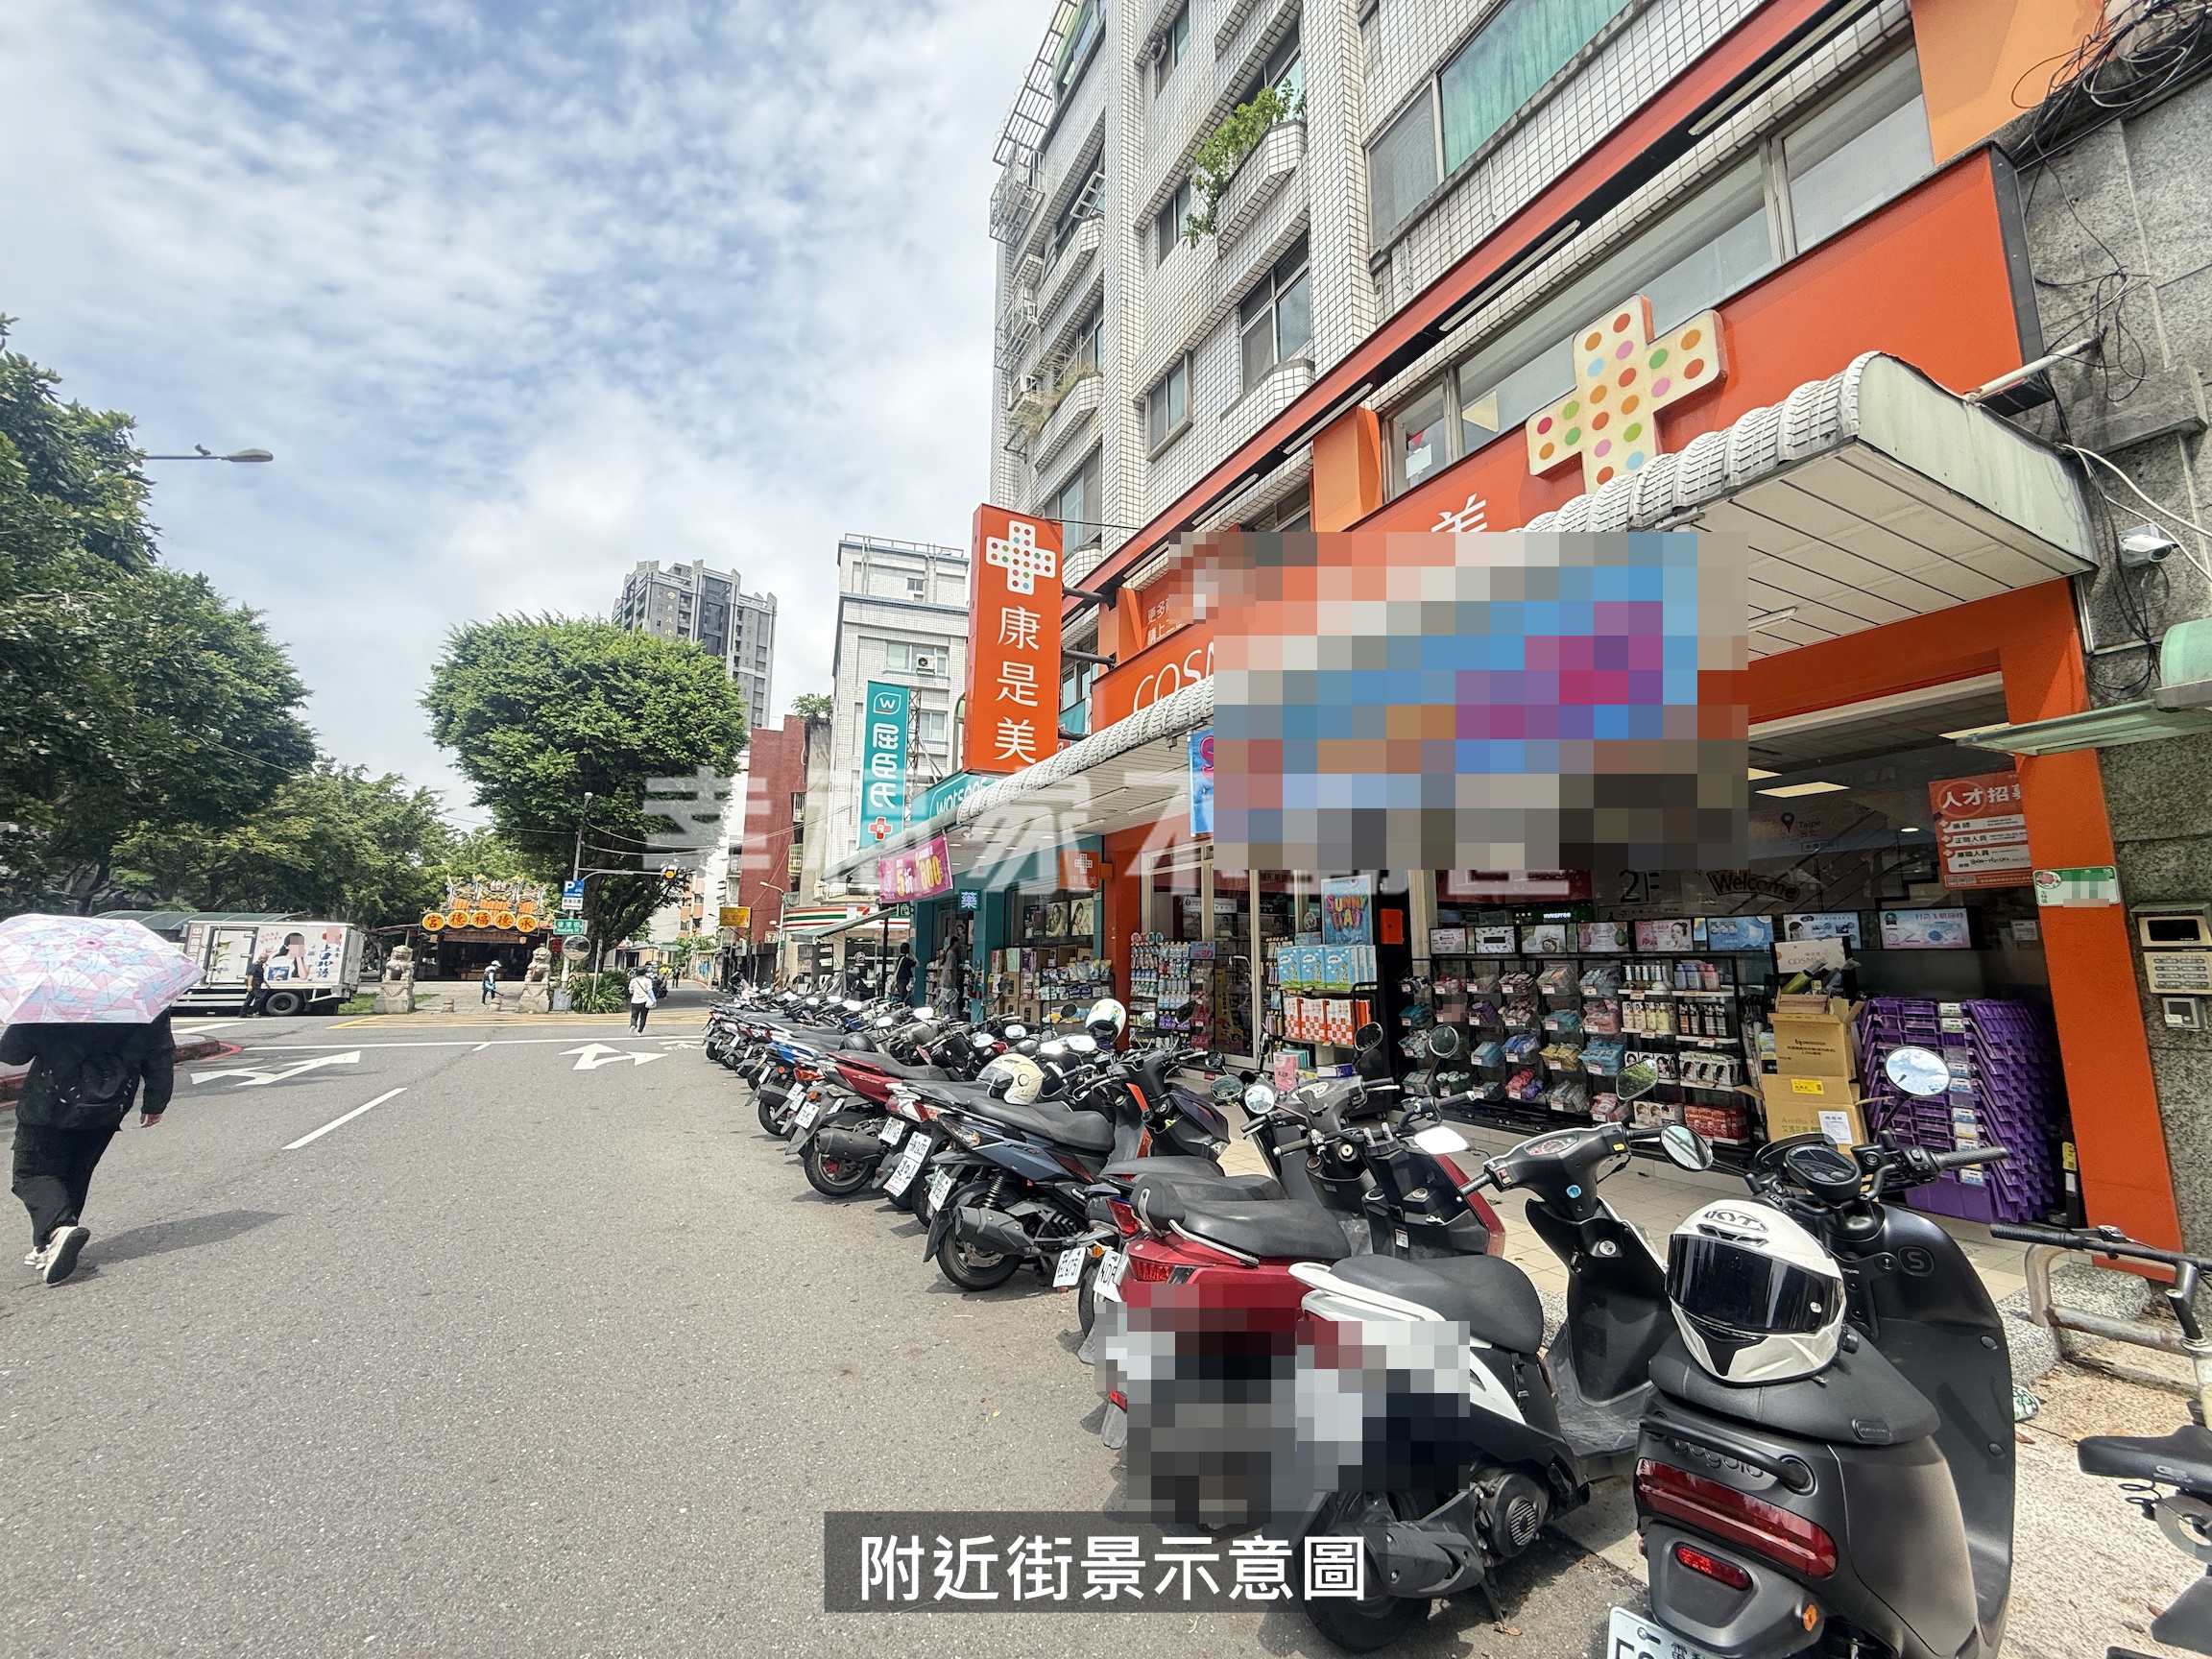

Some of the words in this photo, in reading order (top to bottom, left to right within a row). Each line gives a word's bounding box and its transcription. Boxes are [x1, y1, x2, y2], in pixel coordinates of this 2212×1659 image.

[1147, 619, 1183, 645] 請上二
[994, 605, 1042, 764] 康是美
[870, 722, 900, 808] 屈臣氏
[1955, 834, 1987, 844] 正職人員
[1957, 850, 1989, 858] 兼職人員
[565, 880, 576, 892] P
[1713, 872, 1798, 901] Welcome
[961, 891, 977, 909] 藥
[1325, 894, 1368, 913] SUNNY
[1331, 908, 1363, 929] DAY
